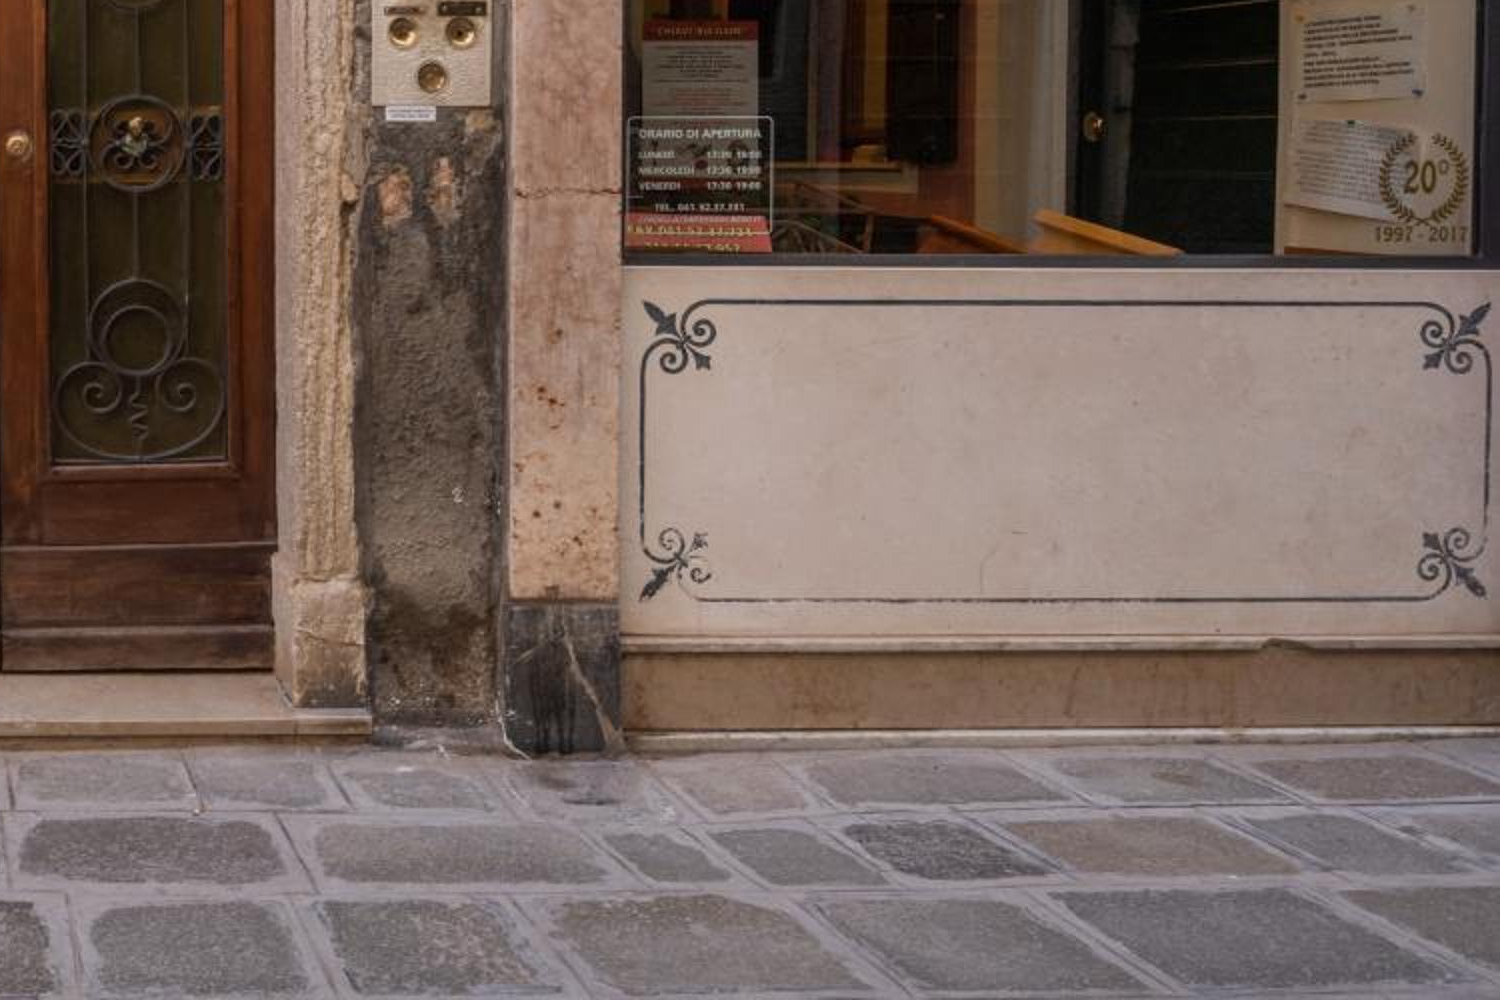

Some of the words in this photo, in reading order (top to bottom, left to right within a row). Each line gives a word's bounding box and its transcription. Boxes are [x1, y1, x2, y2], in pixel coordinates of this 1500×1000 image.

[640, 129, 683, 139] ORARIO
[686, 129, 699, 138] DI
[702, 129, 762, 139] APERTURA
[1404, 160, 1449, 194] 20°
[1375, 226, 1413, 242] 1997
[1428, 226, 1468, 242] 2017
